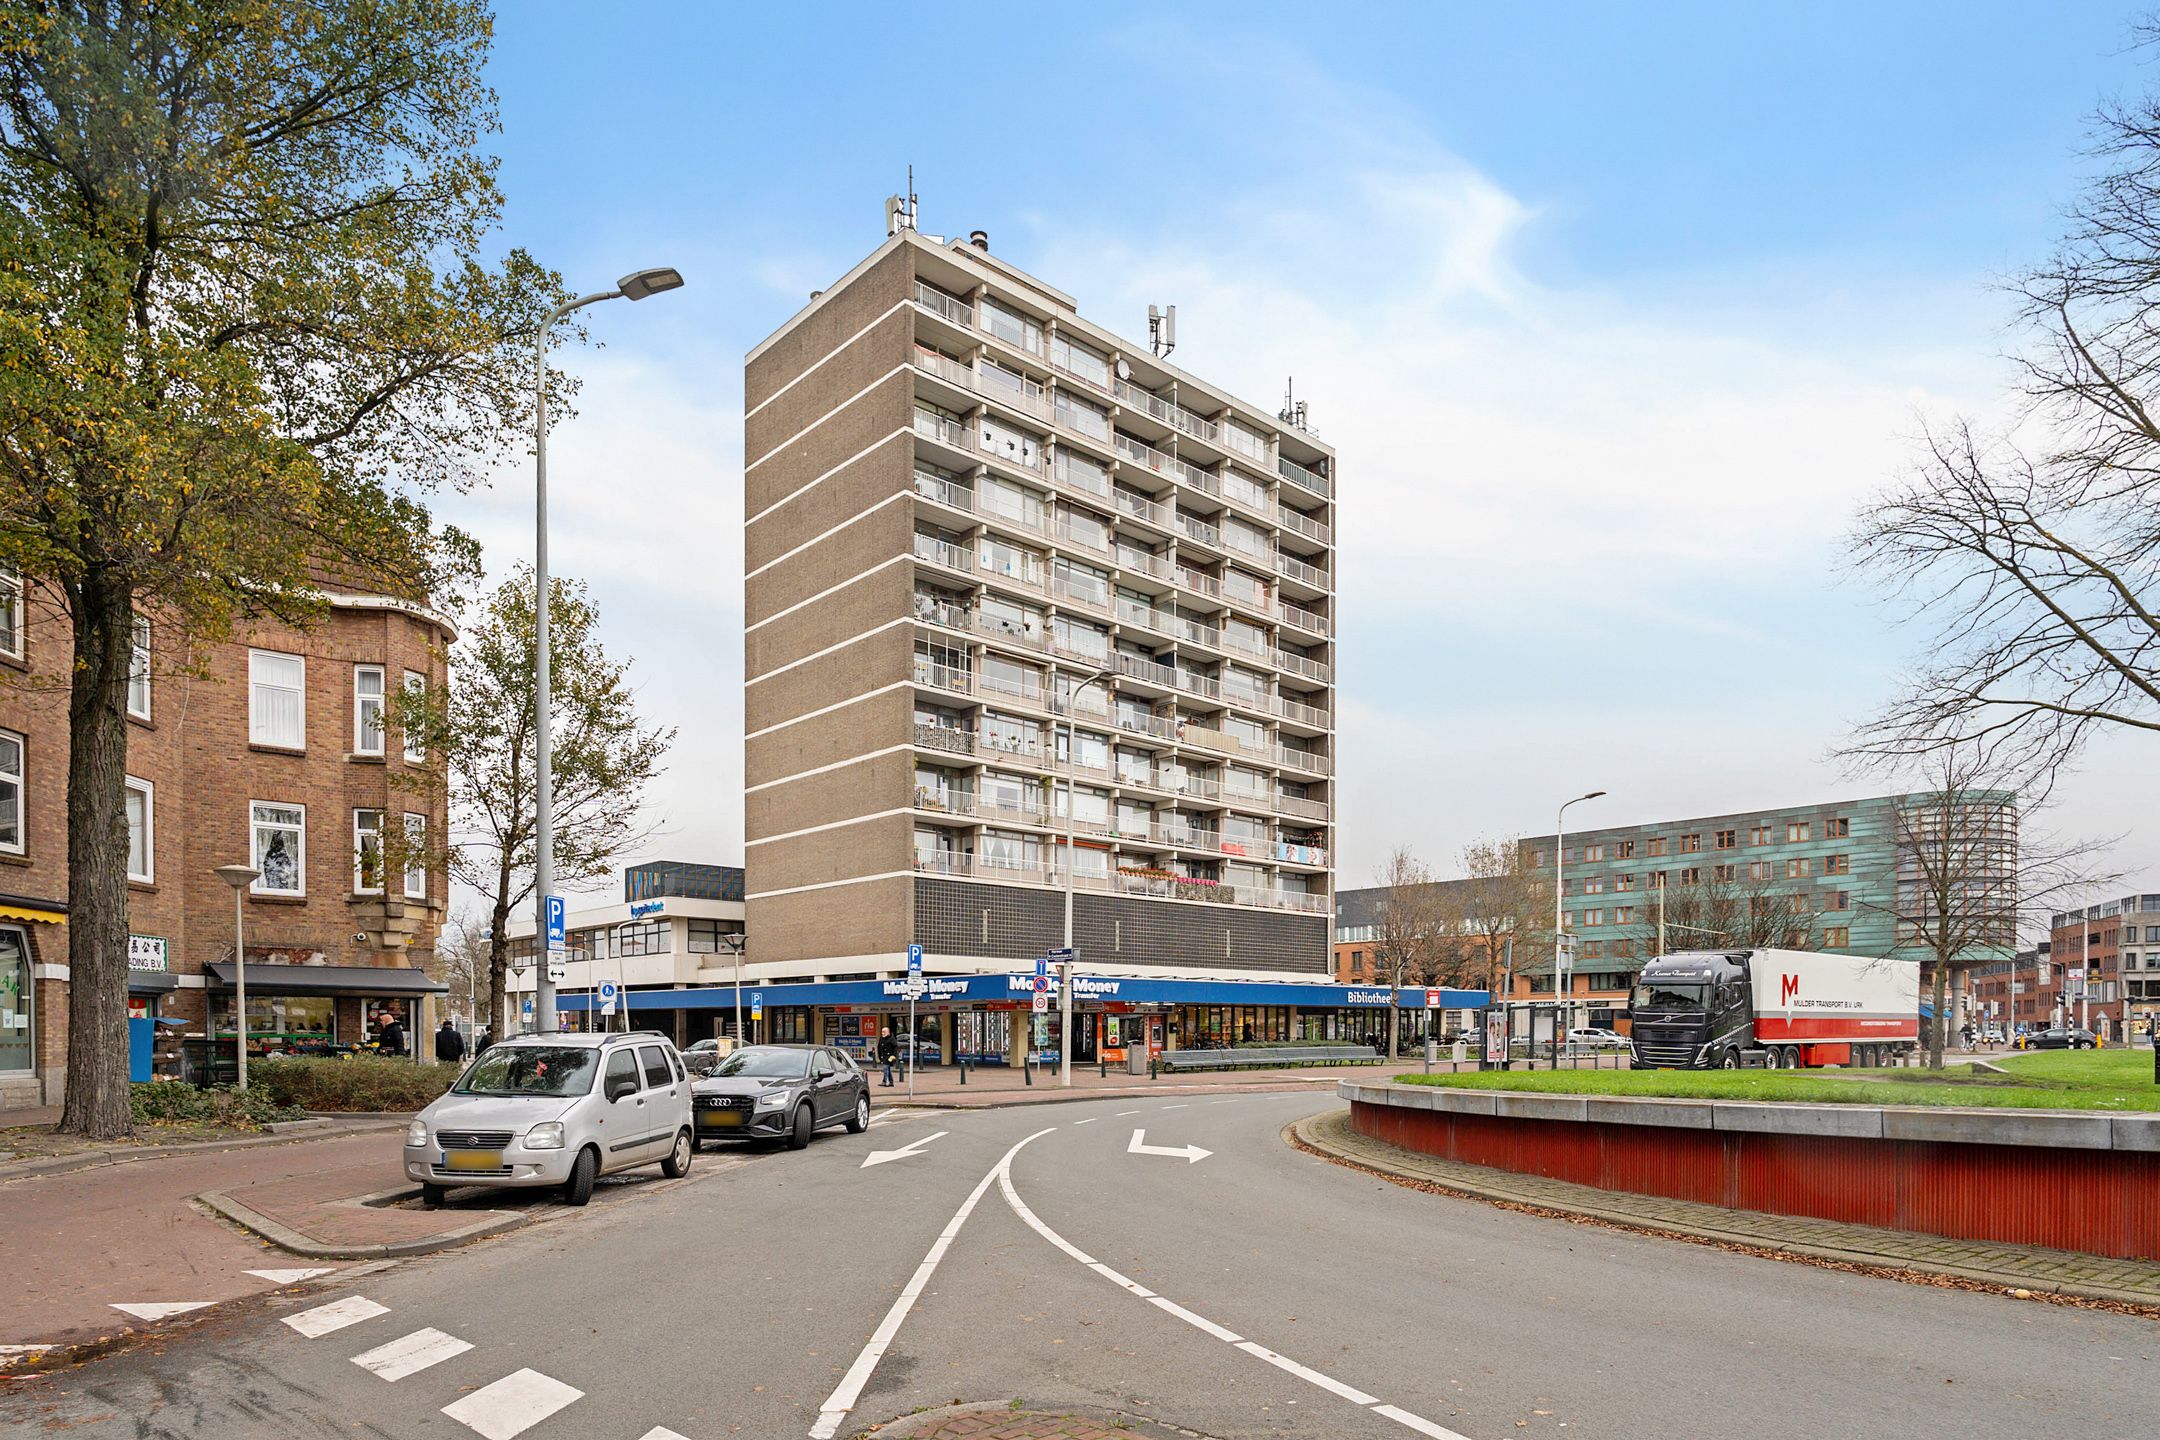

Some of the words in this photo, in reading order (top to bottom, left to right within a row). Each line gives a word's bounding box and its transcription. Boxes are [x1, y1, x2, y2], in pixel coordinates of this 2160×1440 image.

[929, 979, 969, 993] Money
[1072, 979, 1120, 994] Money
[1347, 991, 1393, 1004] Bibliothee
[1793, 999, 1815, 1008] MULDER
[1816, 1000, 1844, 1008] TRANSPORT
